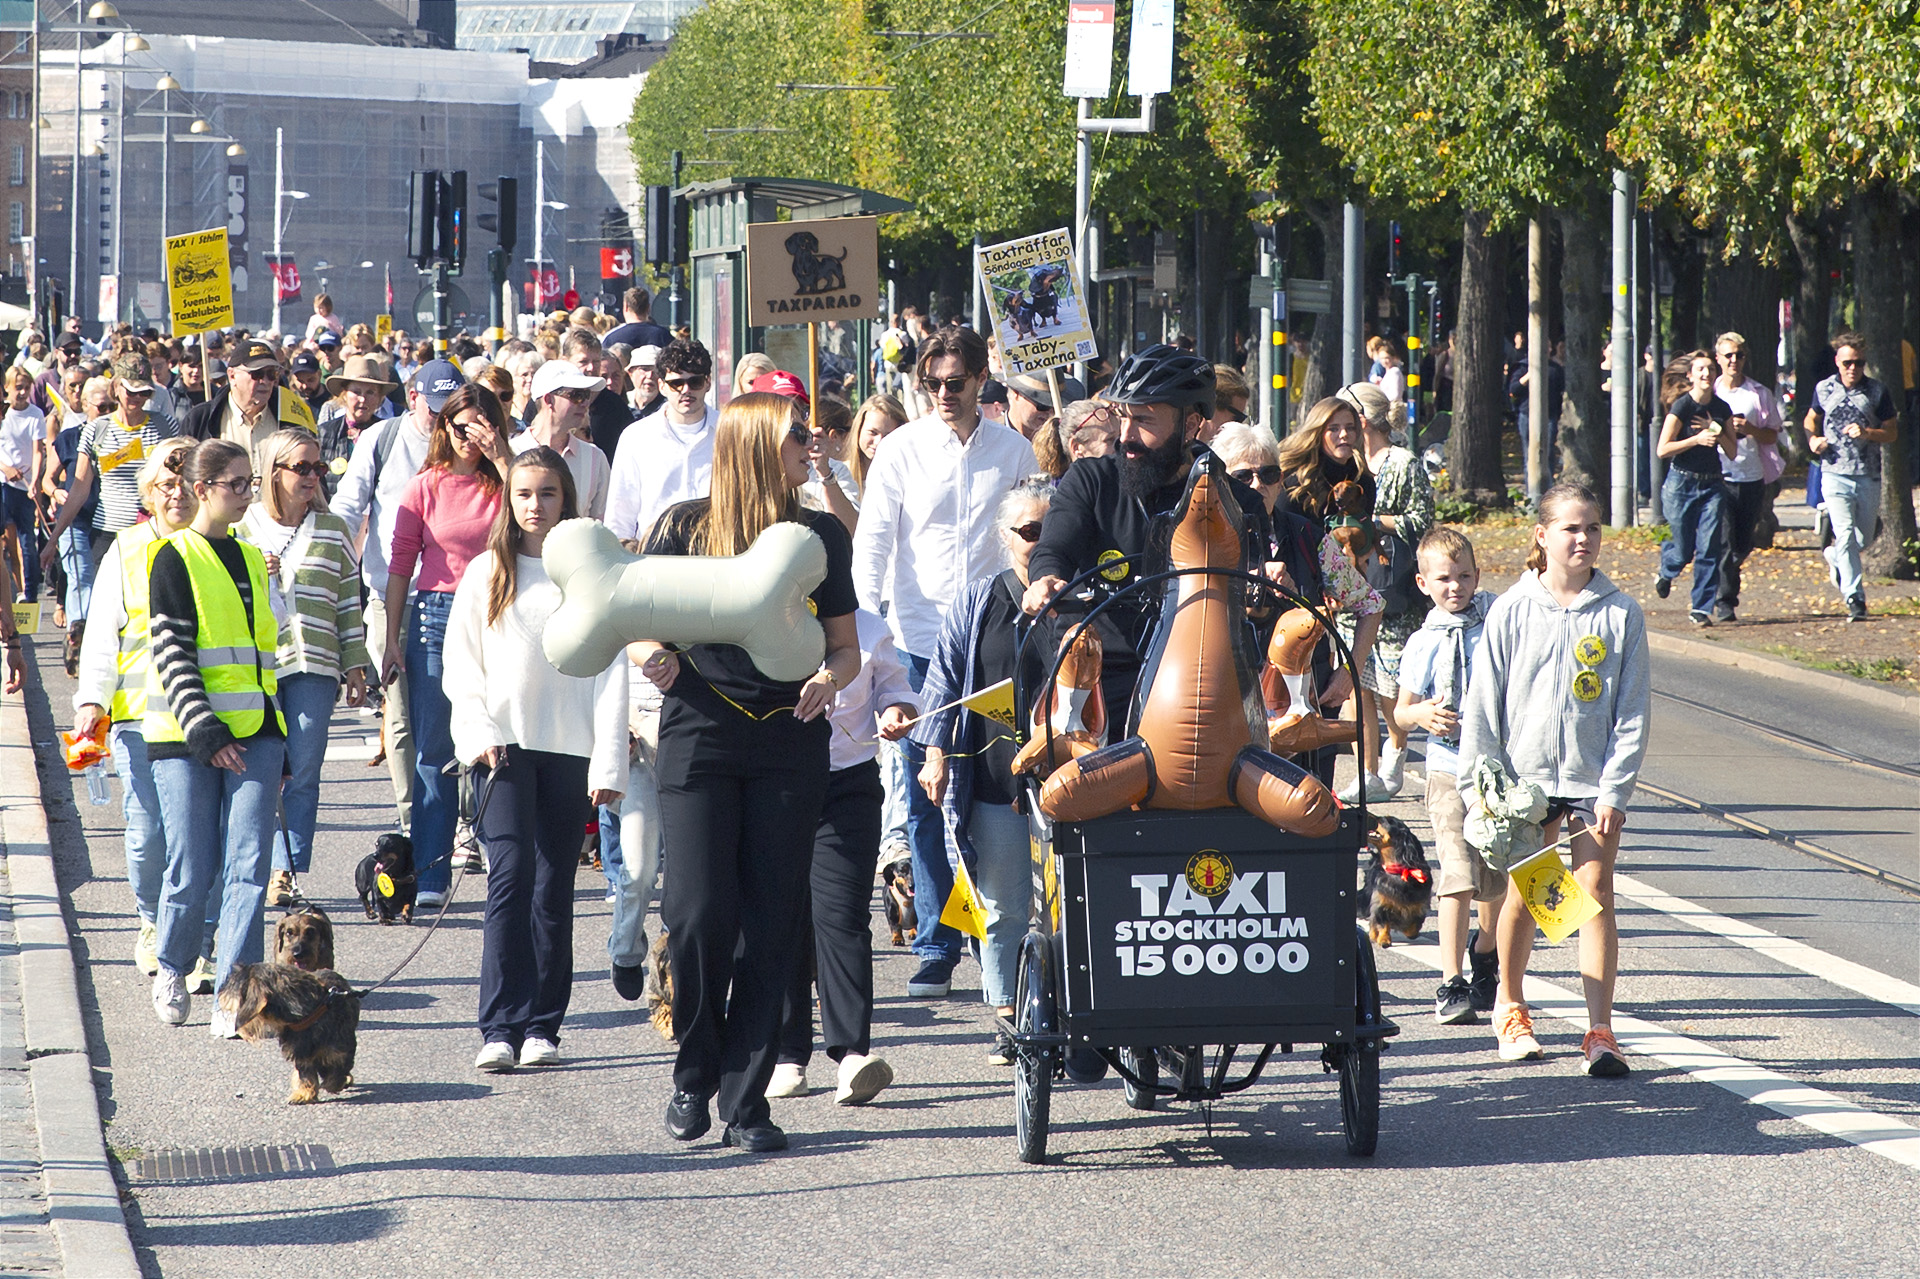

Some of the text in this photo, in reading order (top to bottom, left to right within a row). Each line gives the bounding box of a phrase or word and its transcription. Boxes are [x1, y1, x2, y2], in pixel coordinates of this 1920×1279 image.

[169, 238, 187, 250] TAX
[199, 233, 223, 245] Sthlm
[981, 235, 1066, 263] Taxträffar
[984, 246, 1070, 275] Söndagar 13.00
[175, 304, 230, 321] Taxklubben
[183, 294, 221, 309] Svenska
[767, 294, 862, 313] TAXPARAD
[1020, 340, 1066, 357] Täby-
[1013, 351, 1076, 373] Taxarna
[1131, 871, 1287, 917] TAXI
[1115, 917, 1309, 942] STOCKHOLM
[1116, 941, 1310, 977] 15 00 00
